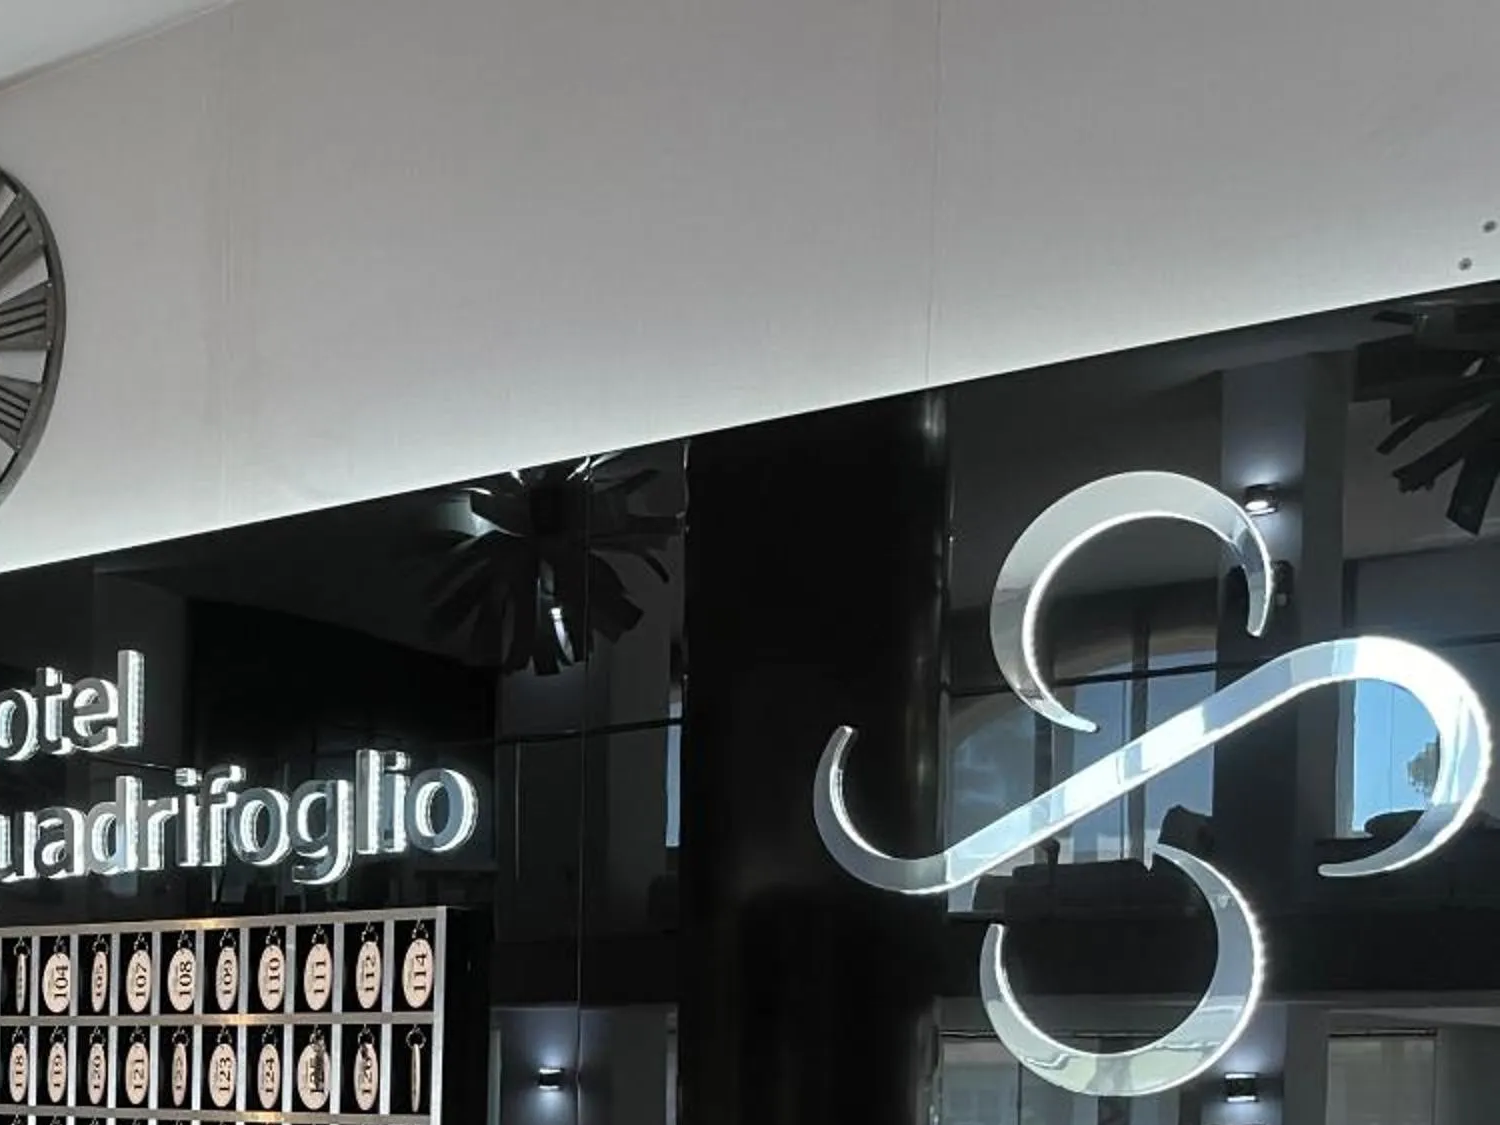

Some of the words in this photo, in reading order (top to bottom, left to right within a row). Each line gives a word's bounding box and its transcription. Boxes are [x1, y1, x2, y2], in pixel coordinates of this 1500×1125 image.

[54, 964, 69, 999] 104
[134, 962, 148, 998] 107
[178, 960, 193, 996] 108
[268, 957, 281, 995] 110
[313, 959, 327, 995] 111
[364, 955, 377, 993] 112
[414, 953, 428, 992] 114
[132, 1056, 145, 1090] 121
[219, 1056, 232, 1092] 123
[264, 1057, 276, 1093] 124
